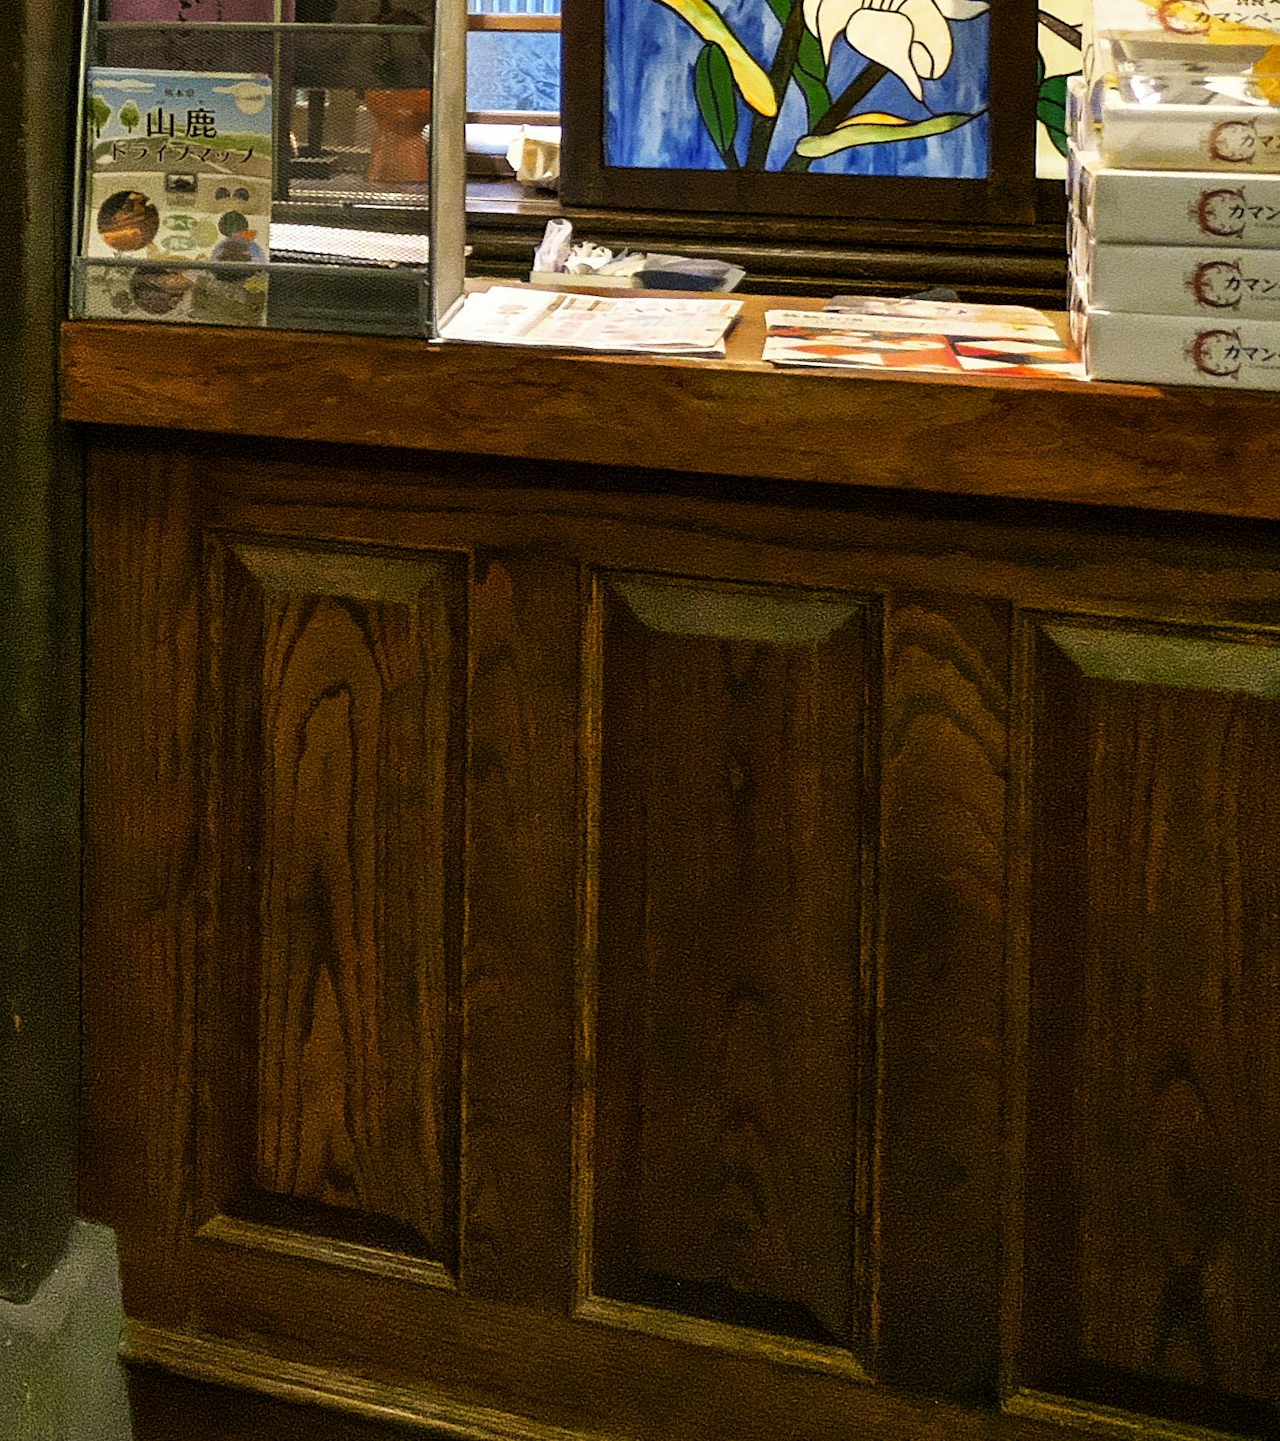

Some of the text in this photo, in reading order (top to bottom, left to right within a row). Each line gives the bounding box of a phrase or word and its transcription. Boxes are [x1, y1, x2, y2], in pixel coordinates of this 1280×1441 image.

[146, 107, 217, 139] 山鹿
[1226, 276, 1280, 293] カマン
[1224, 344, 1280, 362] カマン
